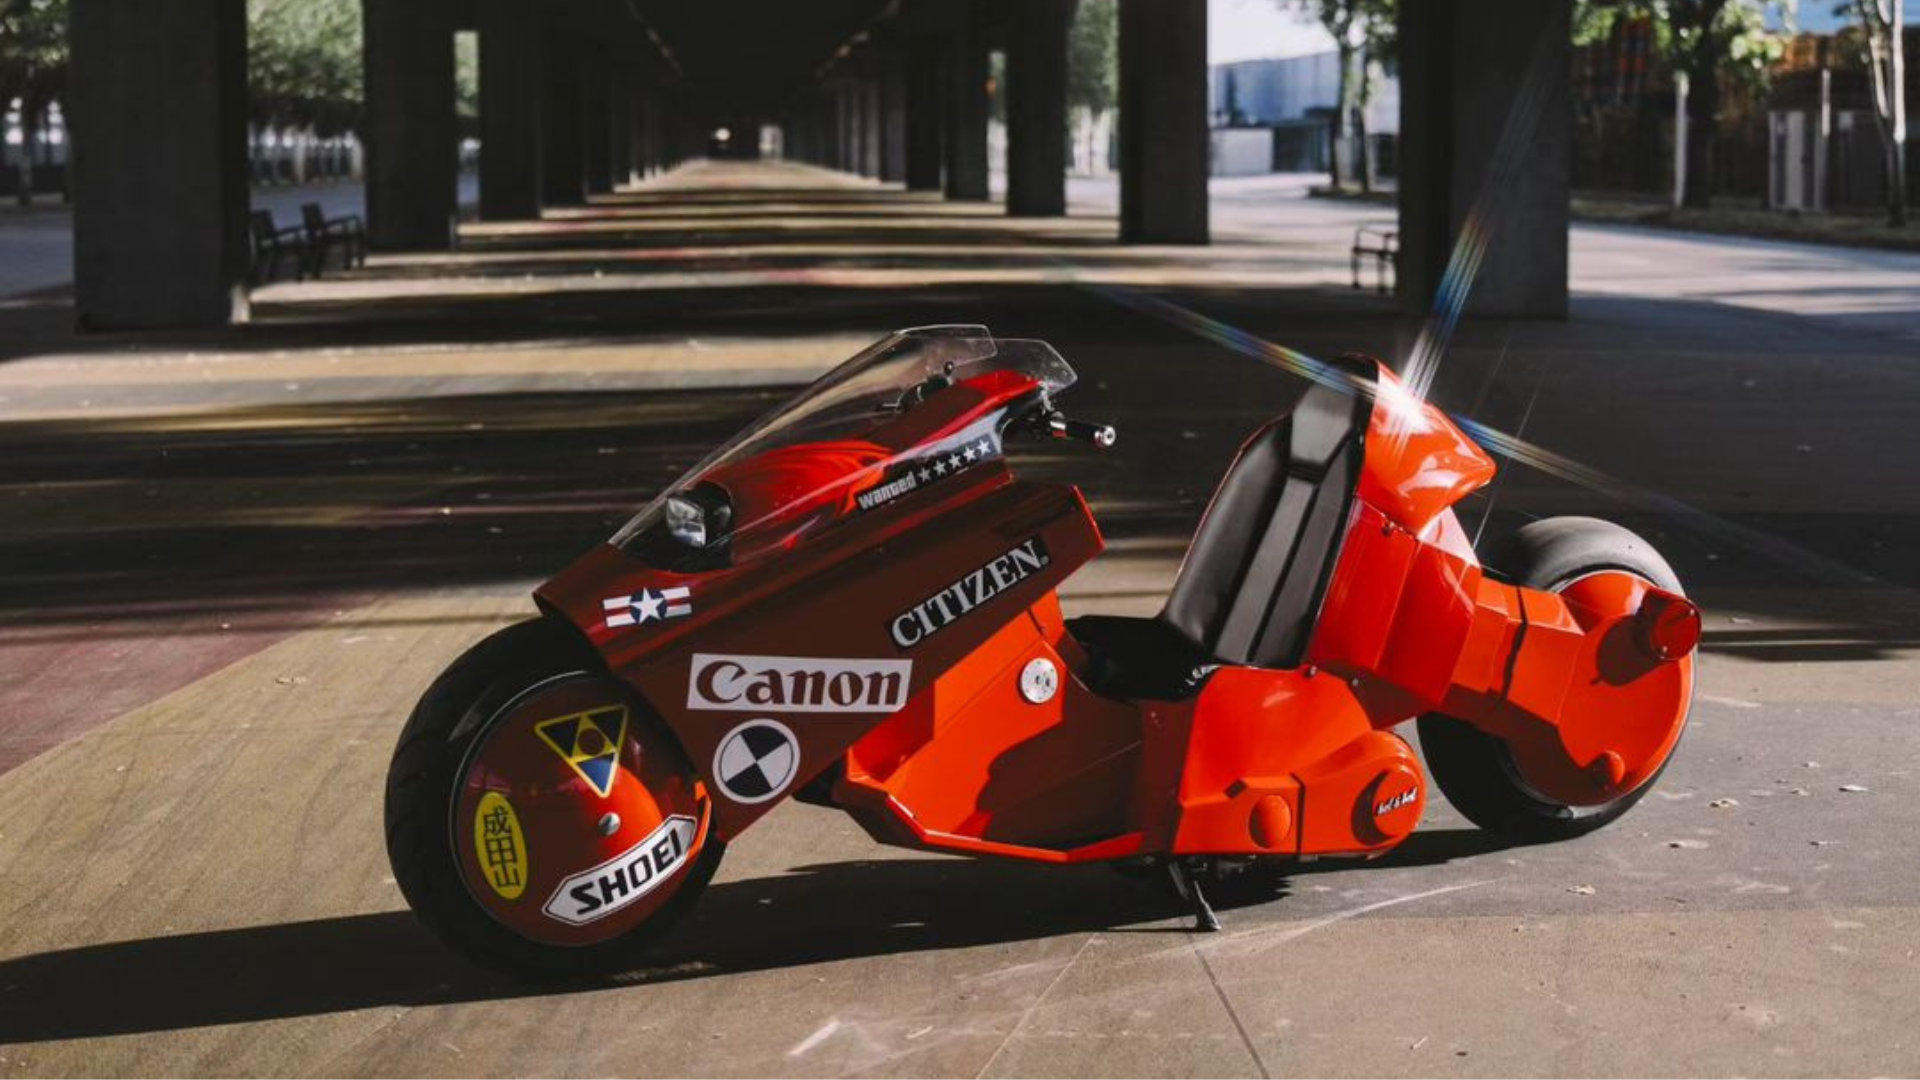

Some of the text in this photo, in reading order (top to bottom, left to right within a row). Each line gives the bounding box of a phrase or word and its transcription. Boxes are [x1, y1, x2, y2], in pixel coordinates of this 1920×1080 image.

[891, 539, 1043, 647] CITIZEN
[696, 660, 902, 707] Canon
[483, 805, 521, 888] 成田山
[569, 828, 681, 915] SHOEI
